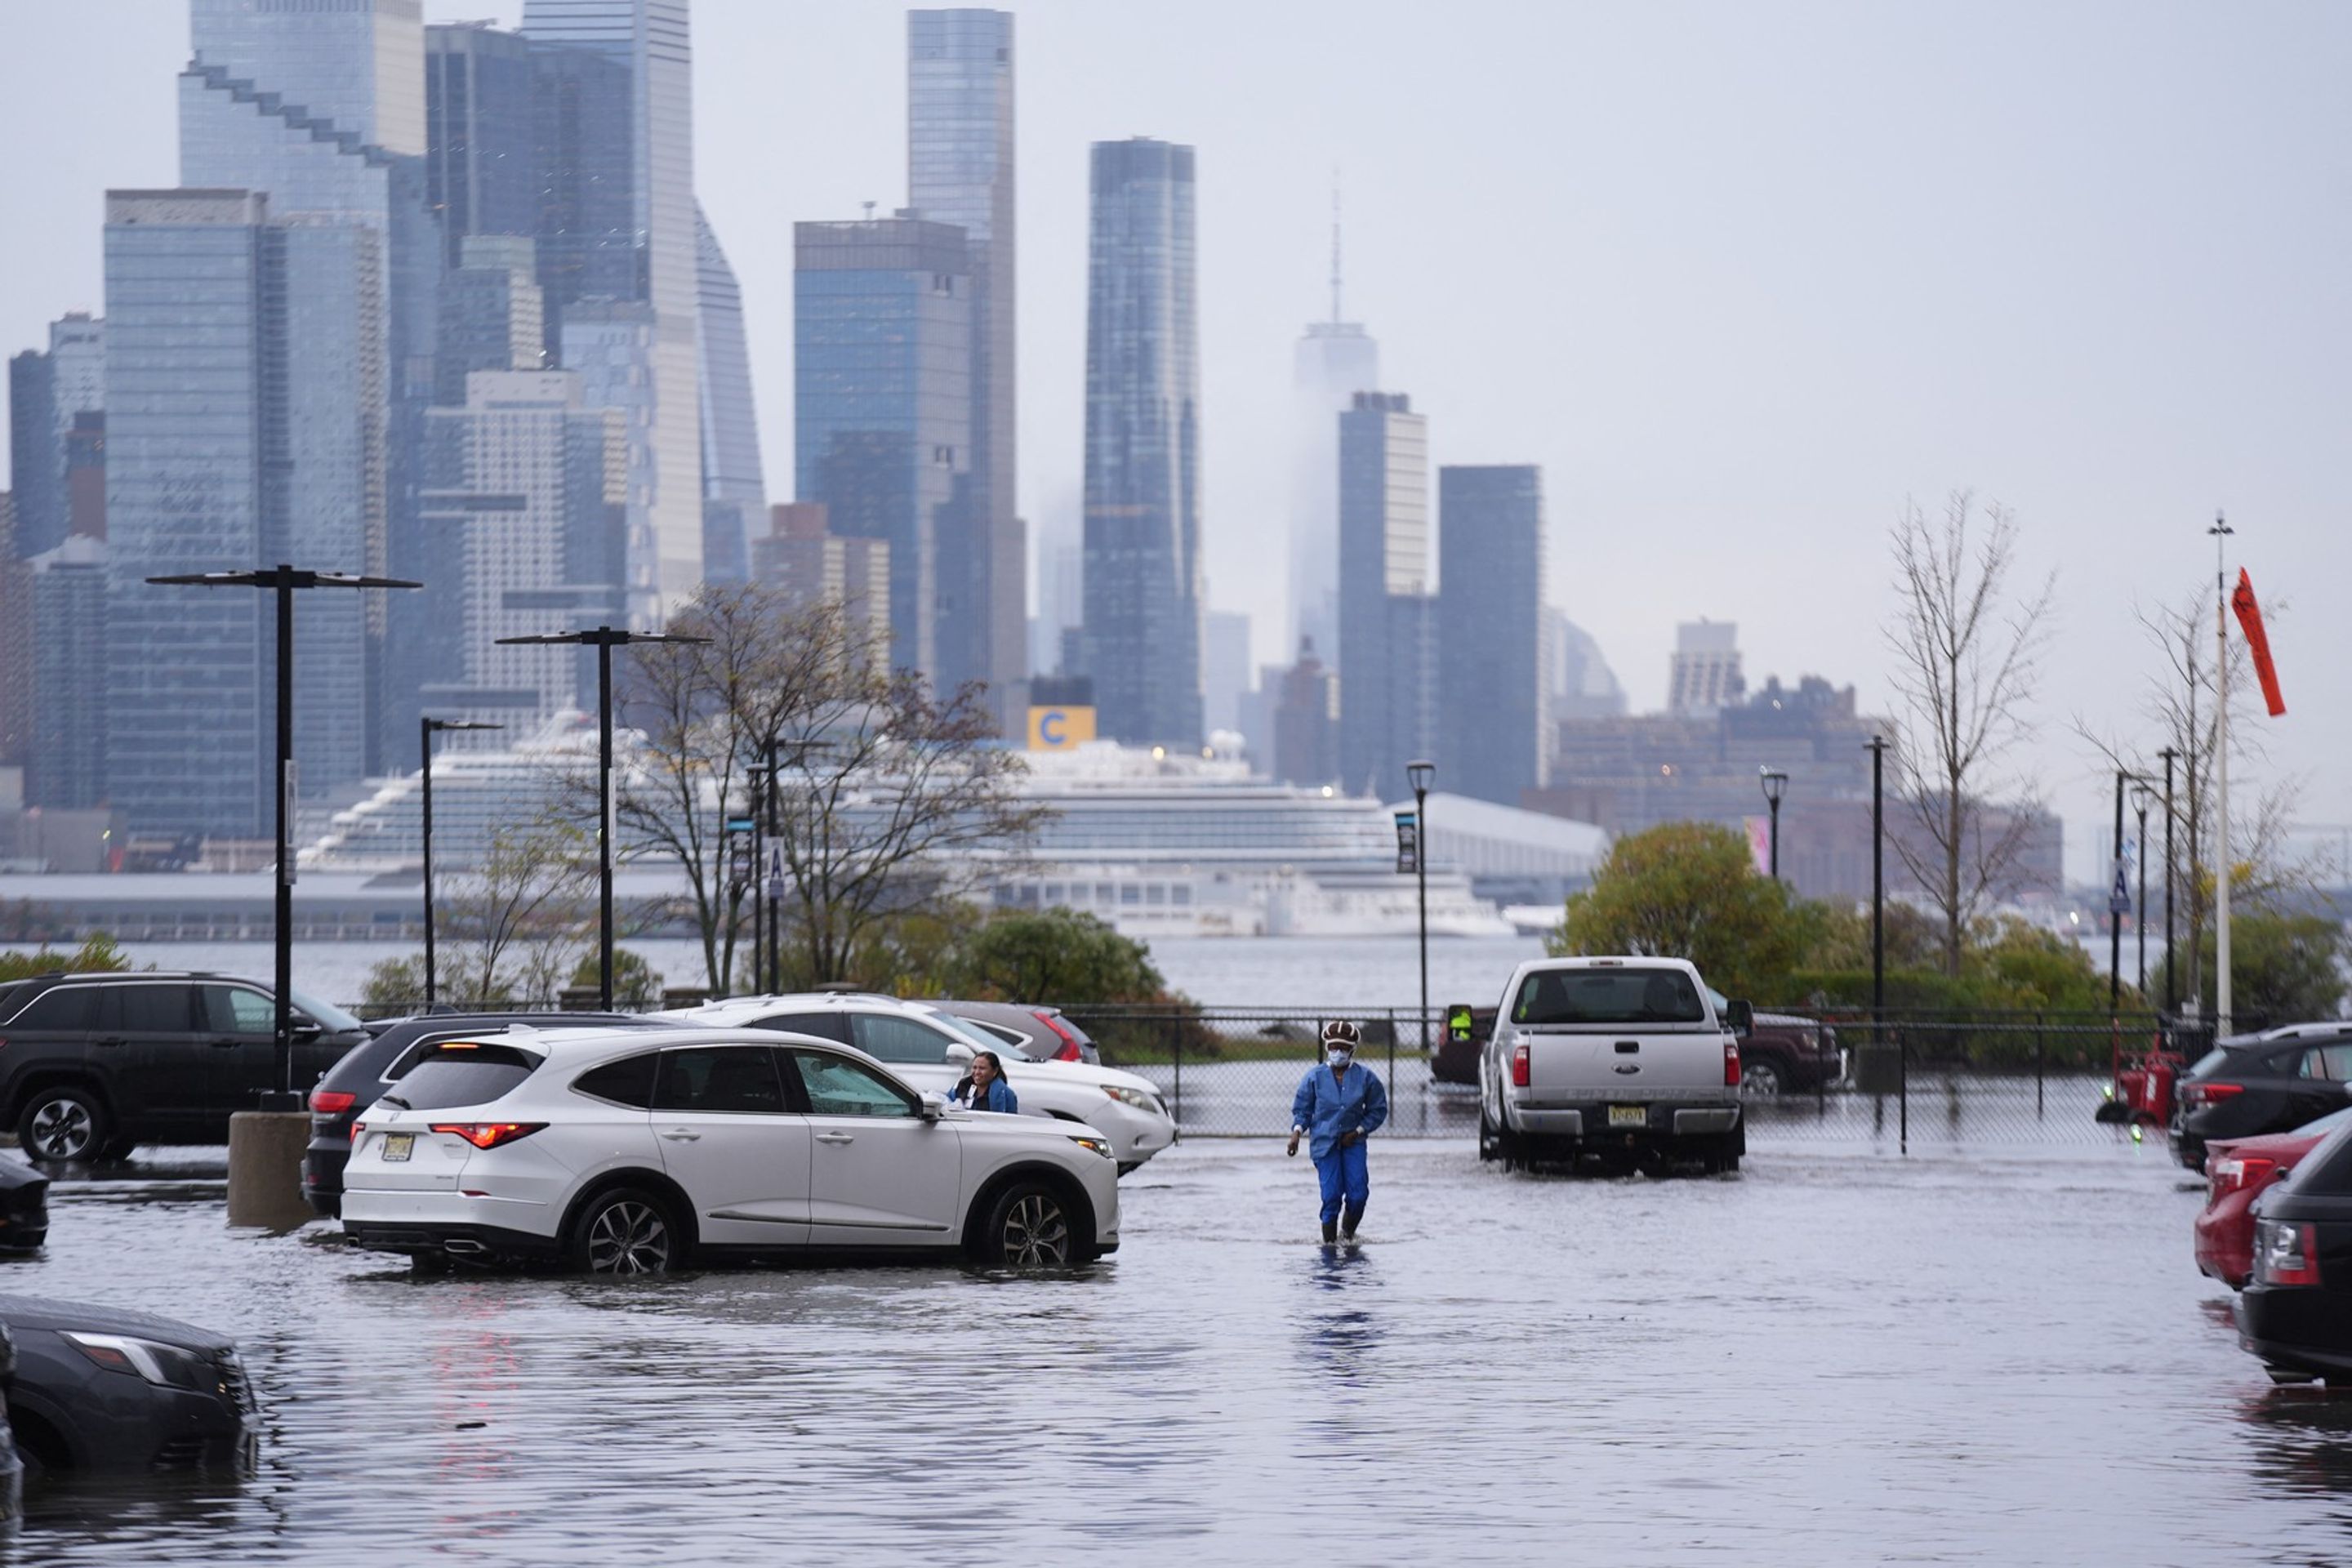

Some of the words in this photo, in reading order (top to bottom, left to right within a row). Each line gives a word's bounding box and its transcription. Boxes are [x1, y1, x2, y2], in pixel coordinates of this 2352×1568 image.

[1040, 711, 1067, 746] C
[772, 847, 782, 878] A
[2114, 869, 2127, 898] A
